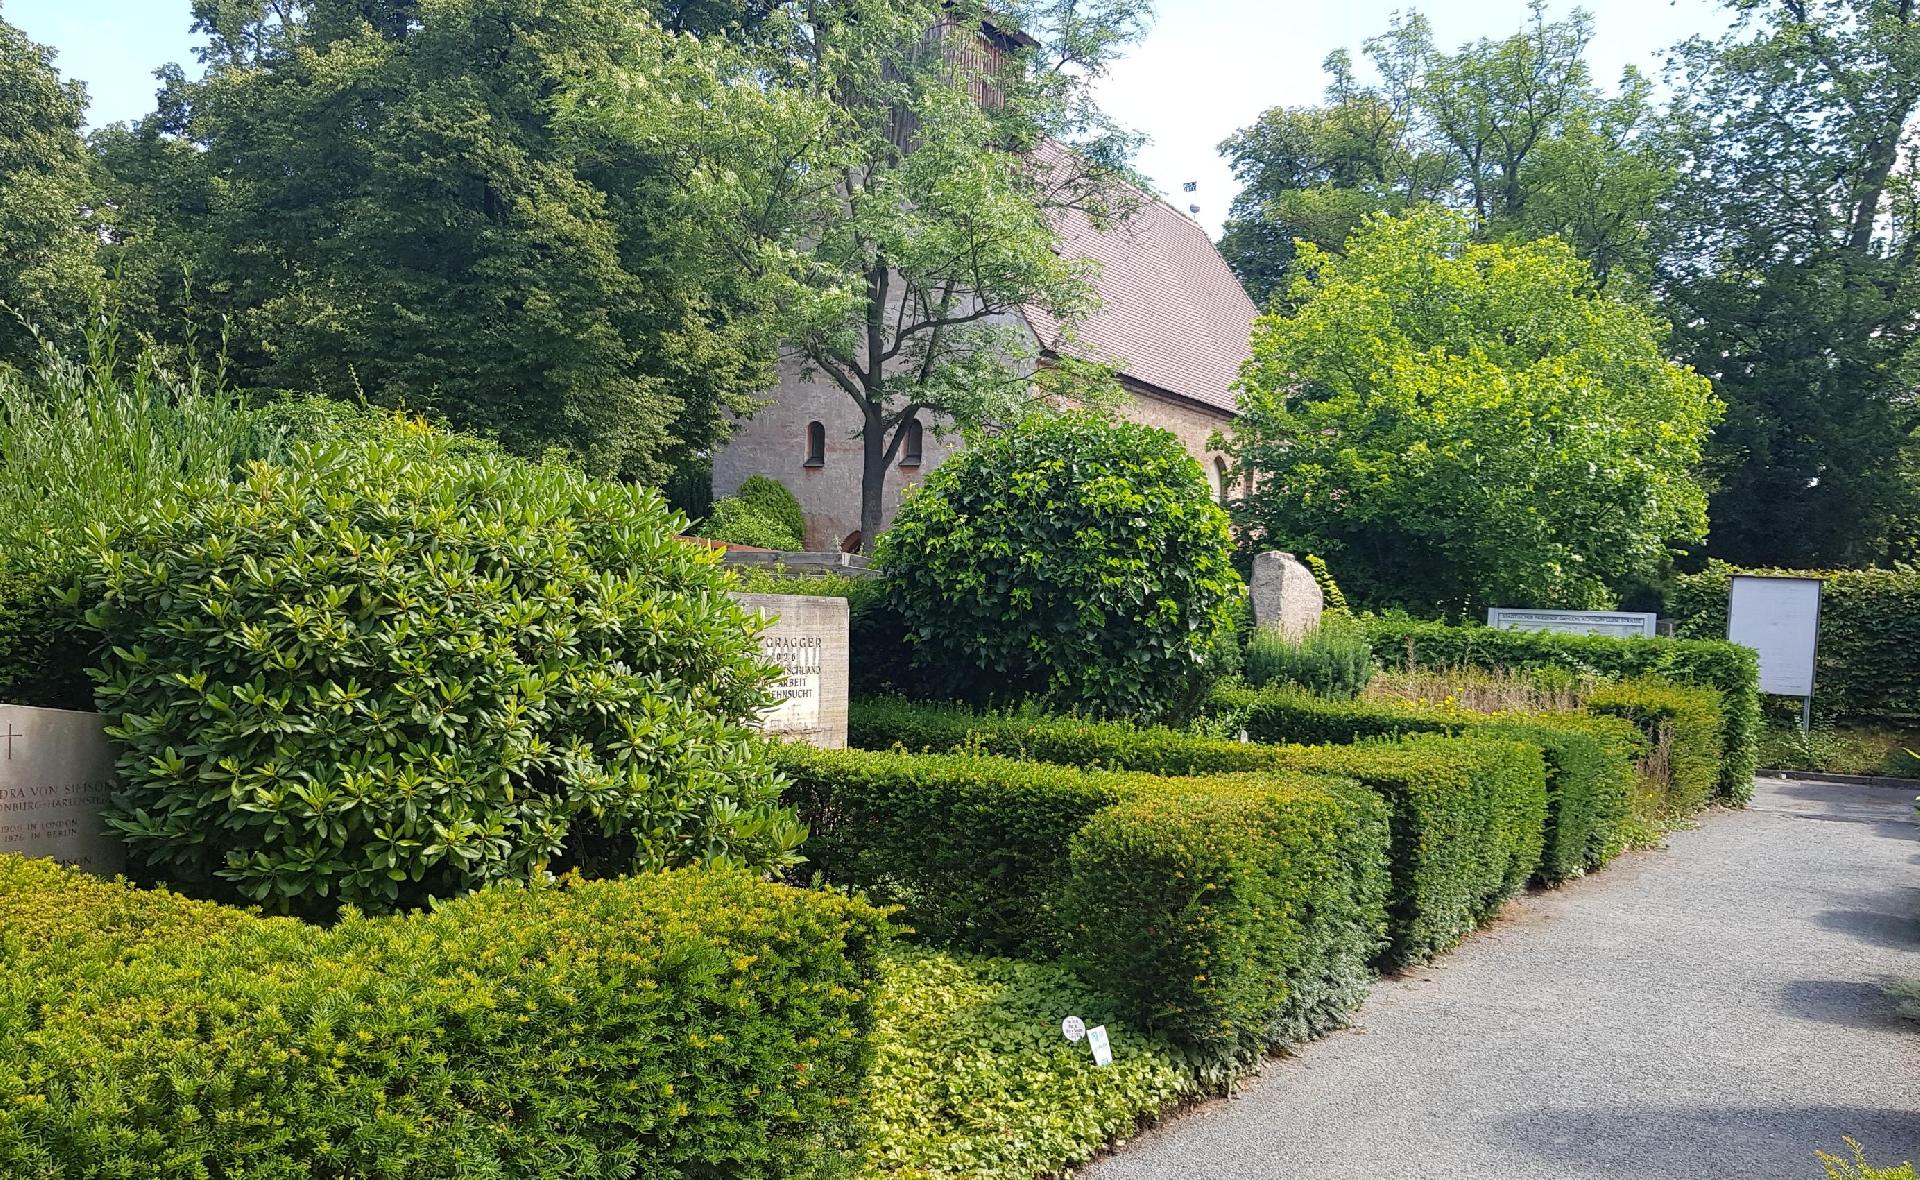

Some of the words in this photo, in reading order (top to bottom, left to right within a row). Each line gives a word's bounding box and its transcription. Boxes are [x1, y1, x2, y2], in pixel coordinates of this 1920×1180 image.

[766, 637, 822, 647] GRAGGER
[783, 665, 821, 675] TSCHLAND
[777, 678, 807, 688] ARBEIT
[771, 689, 812, 699] EHNSUCHT
[30, 784, 57, 796] VON
[27, 823, 37, 831] IN
[31, 832, 40, 840] IN
[47, 828, 77, 839] BERLIN
